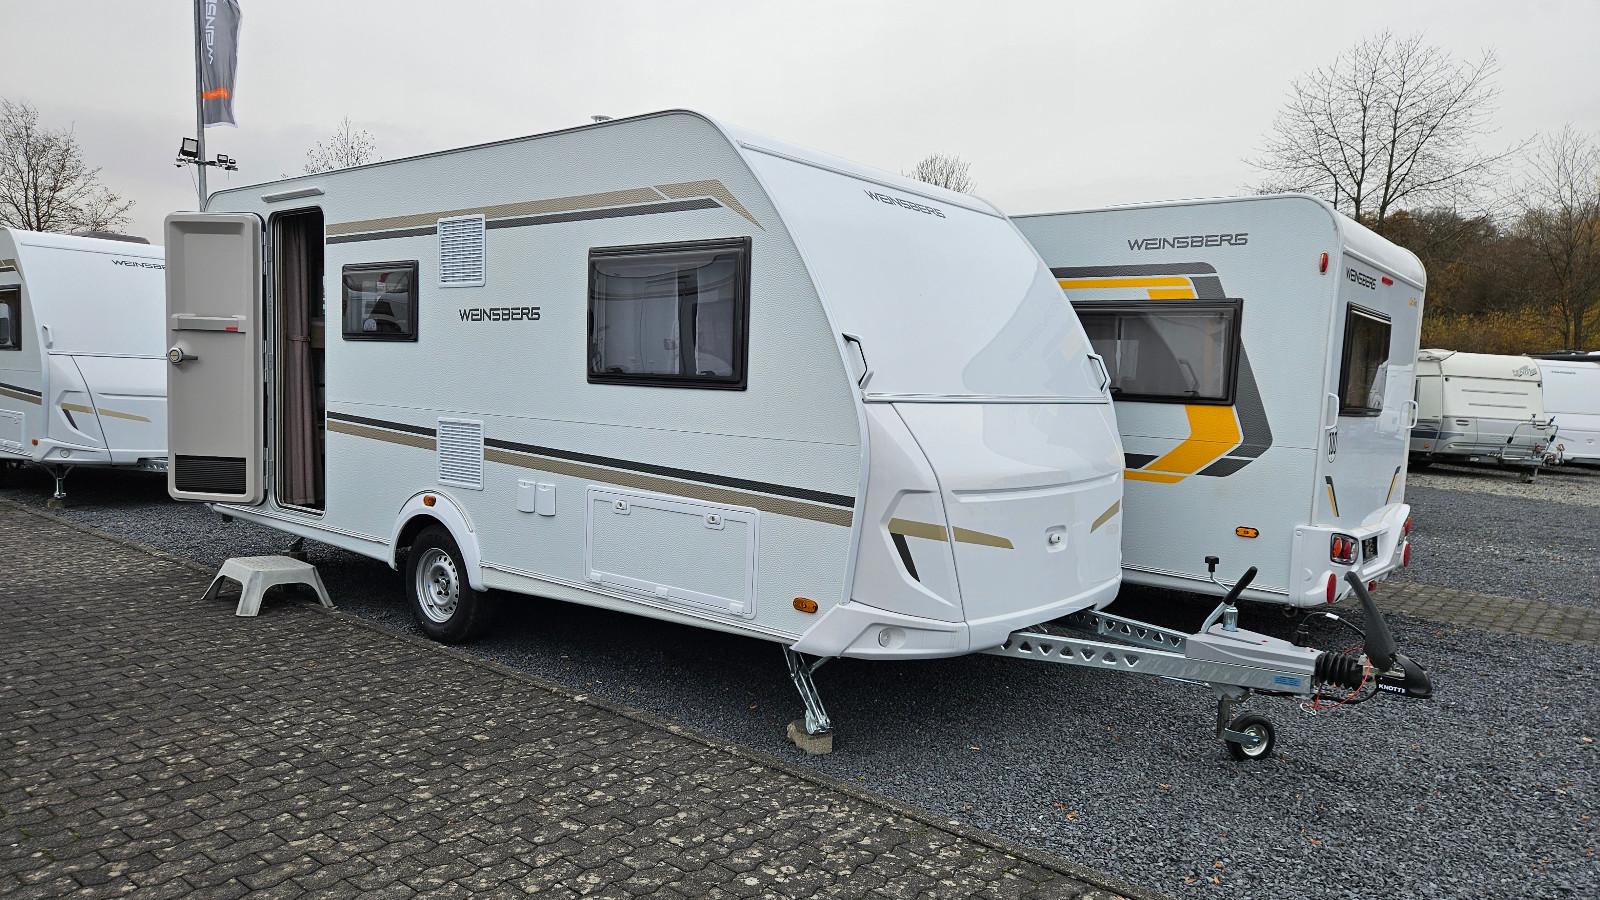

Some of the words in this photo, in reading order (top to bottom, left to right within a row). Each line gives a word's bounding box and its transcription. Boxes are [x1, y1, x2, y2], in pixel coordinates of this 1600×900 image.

[205, 0, 217, 64] WEINS
[863, 188, 946, 218] WEINSBERG
[1127, 233, 1248, 251] WEINSBERG
[458, 306, 541, 322] WEINSBERG
